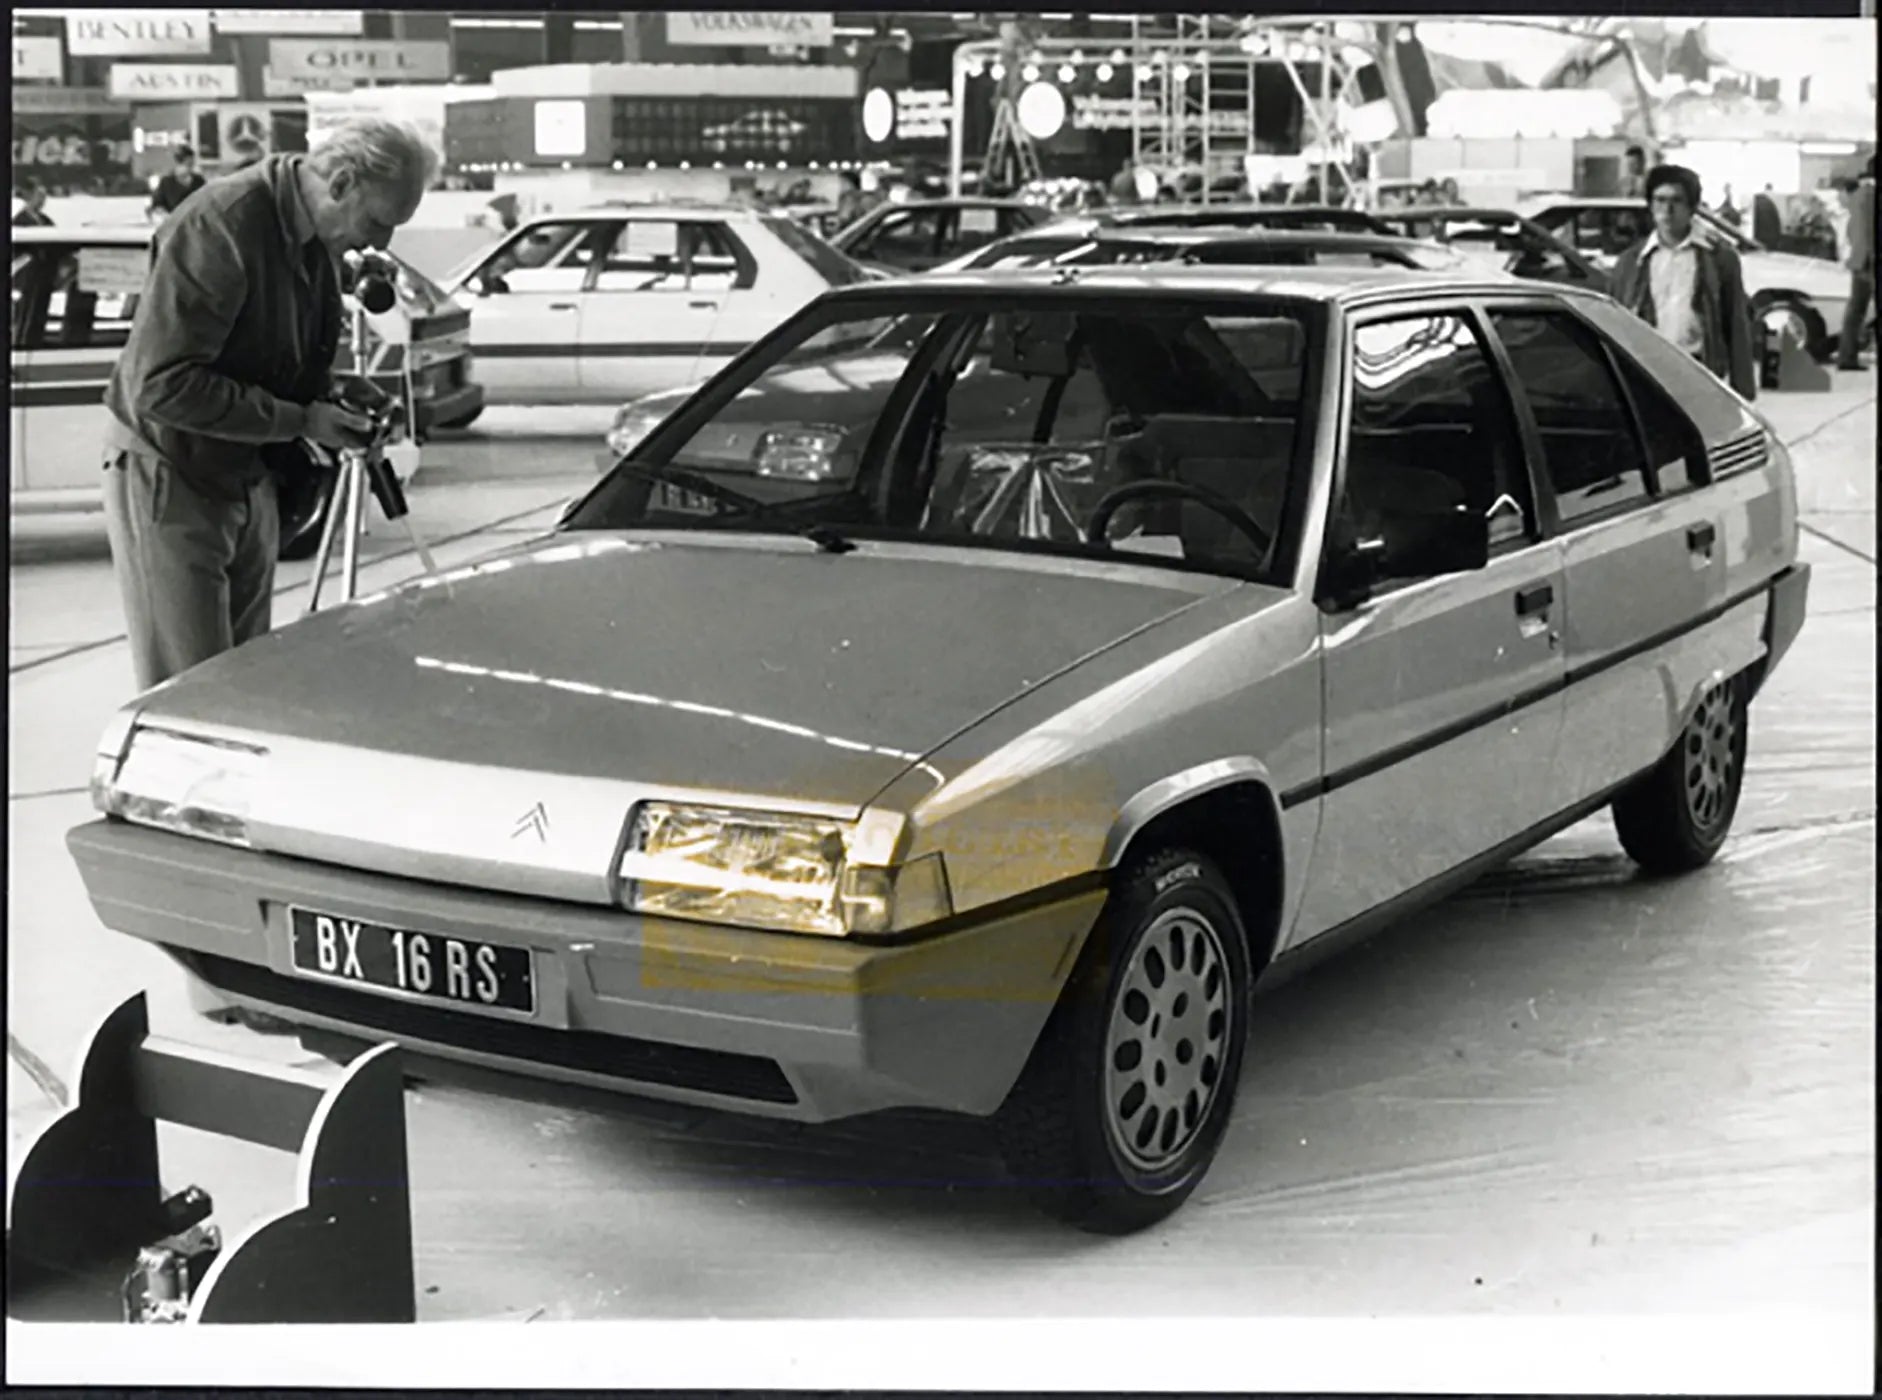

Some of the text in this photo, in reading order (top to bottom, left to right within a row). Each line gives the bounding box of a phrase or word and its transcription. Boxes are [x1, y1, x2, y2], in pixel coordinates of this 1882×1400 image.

[77, 18, 196, 40] BENTLEY
[306, 50, 417, 68] OPEL
[129, 72, 223, 89] AUSTIN
[316, 916, 499, 1004] BX 16 RS
